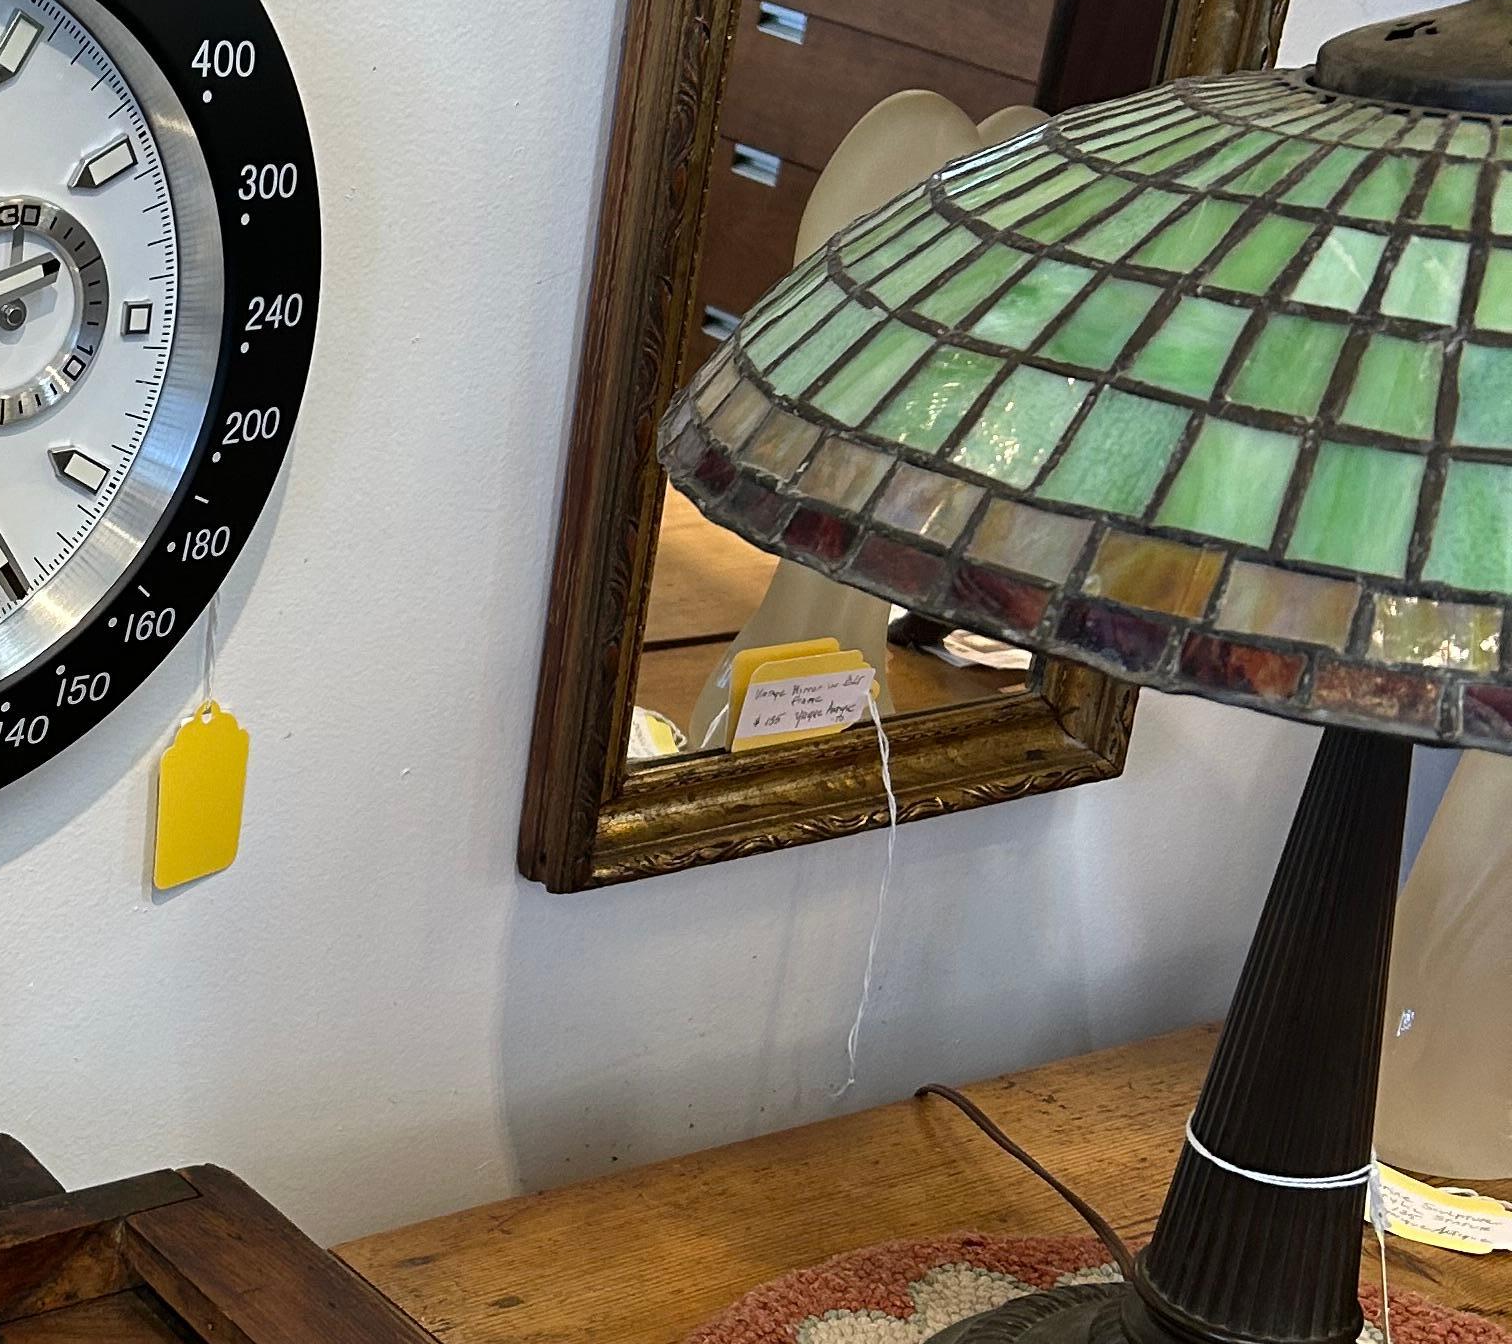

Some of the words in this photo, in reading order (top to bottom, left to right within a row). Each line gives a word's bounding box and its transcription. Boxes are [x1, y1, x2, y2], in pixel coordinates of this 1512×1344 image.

[191, 39, 256, 78] 400
[238, 162, 298, 201] 300
[0, 204, 41, 227] 30
[244, 292, 303, 332] 240
[63, 344, 94, 381] 10
[221, 406, 282, 445] 200
[181, 525, 231, 562] 180
[124, 607, 177, 644] 160
[55, 671, 112, 707] 150
